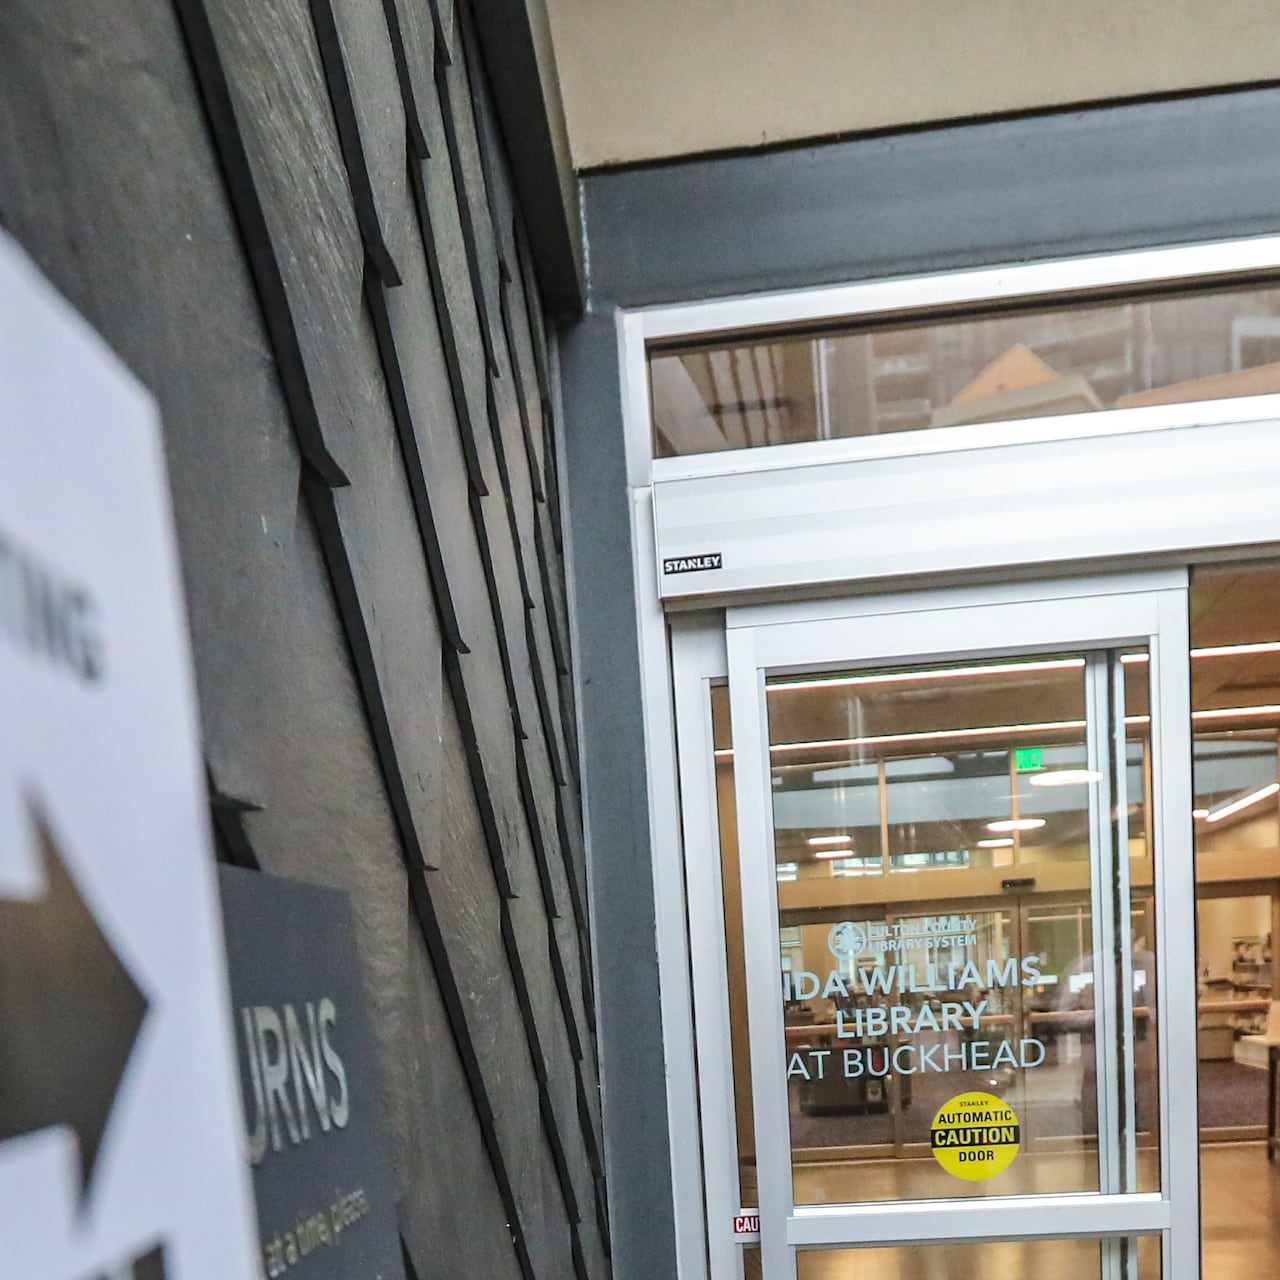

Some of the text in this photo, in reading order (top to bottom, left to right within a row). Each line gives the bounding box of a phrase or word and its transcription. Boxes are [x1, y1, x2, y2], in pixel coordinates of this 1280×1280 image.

[664, 556, 720, 573] STANLEY
[868, 933, 978, 953] LIBRARY SYSTEM
[857, 955, 1041, 997] WILLIAMS
[835, 1000, 989, 1040] LIBRARY
[786, 1038, 1047, 1082] AT BUCKHEAD
[938, 1110, 1012, 1124] AUTOMATIC
[934, 1127, 1015, 1146] CAUTION
[959, 1150, 994, 1162] DOOR
